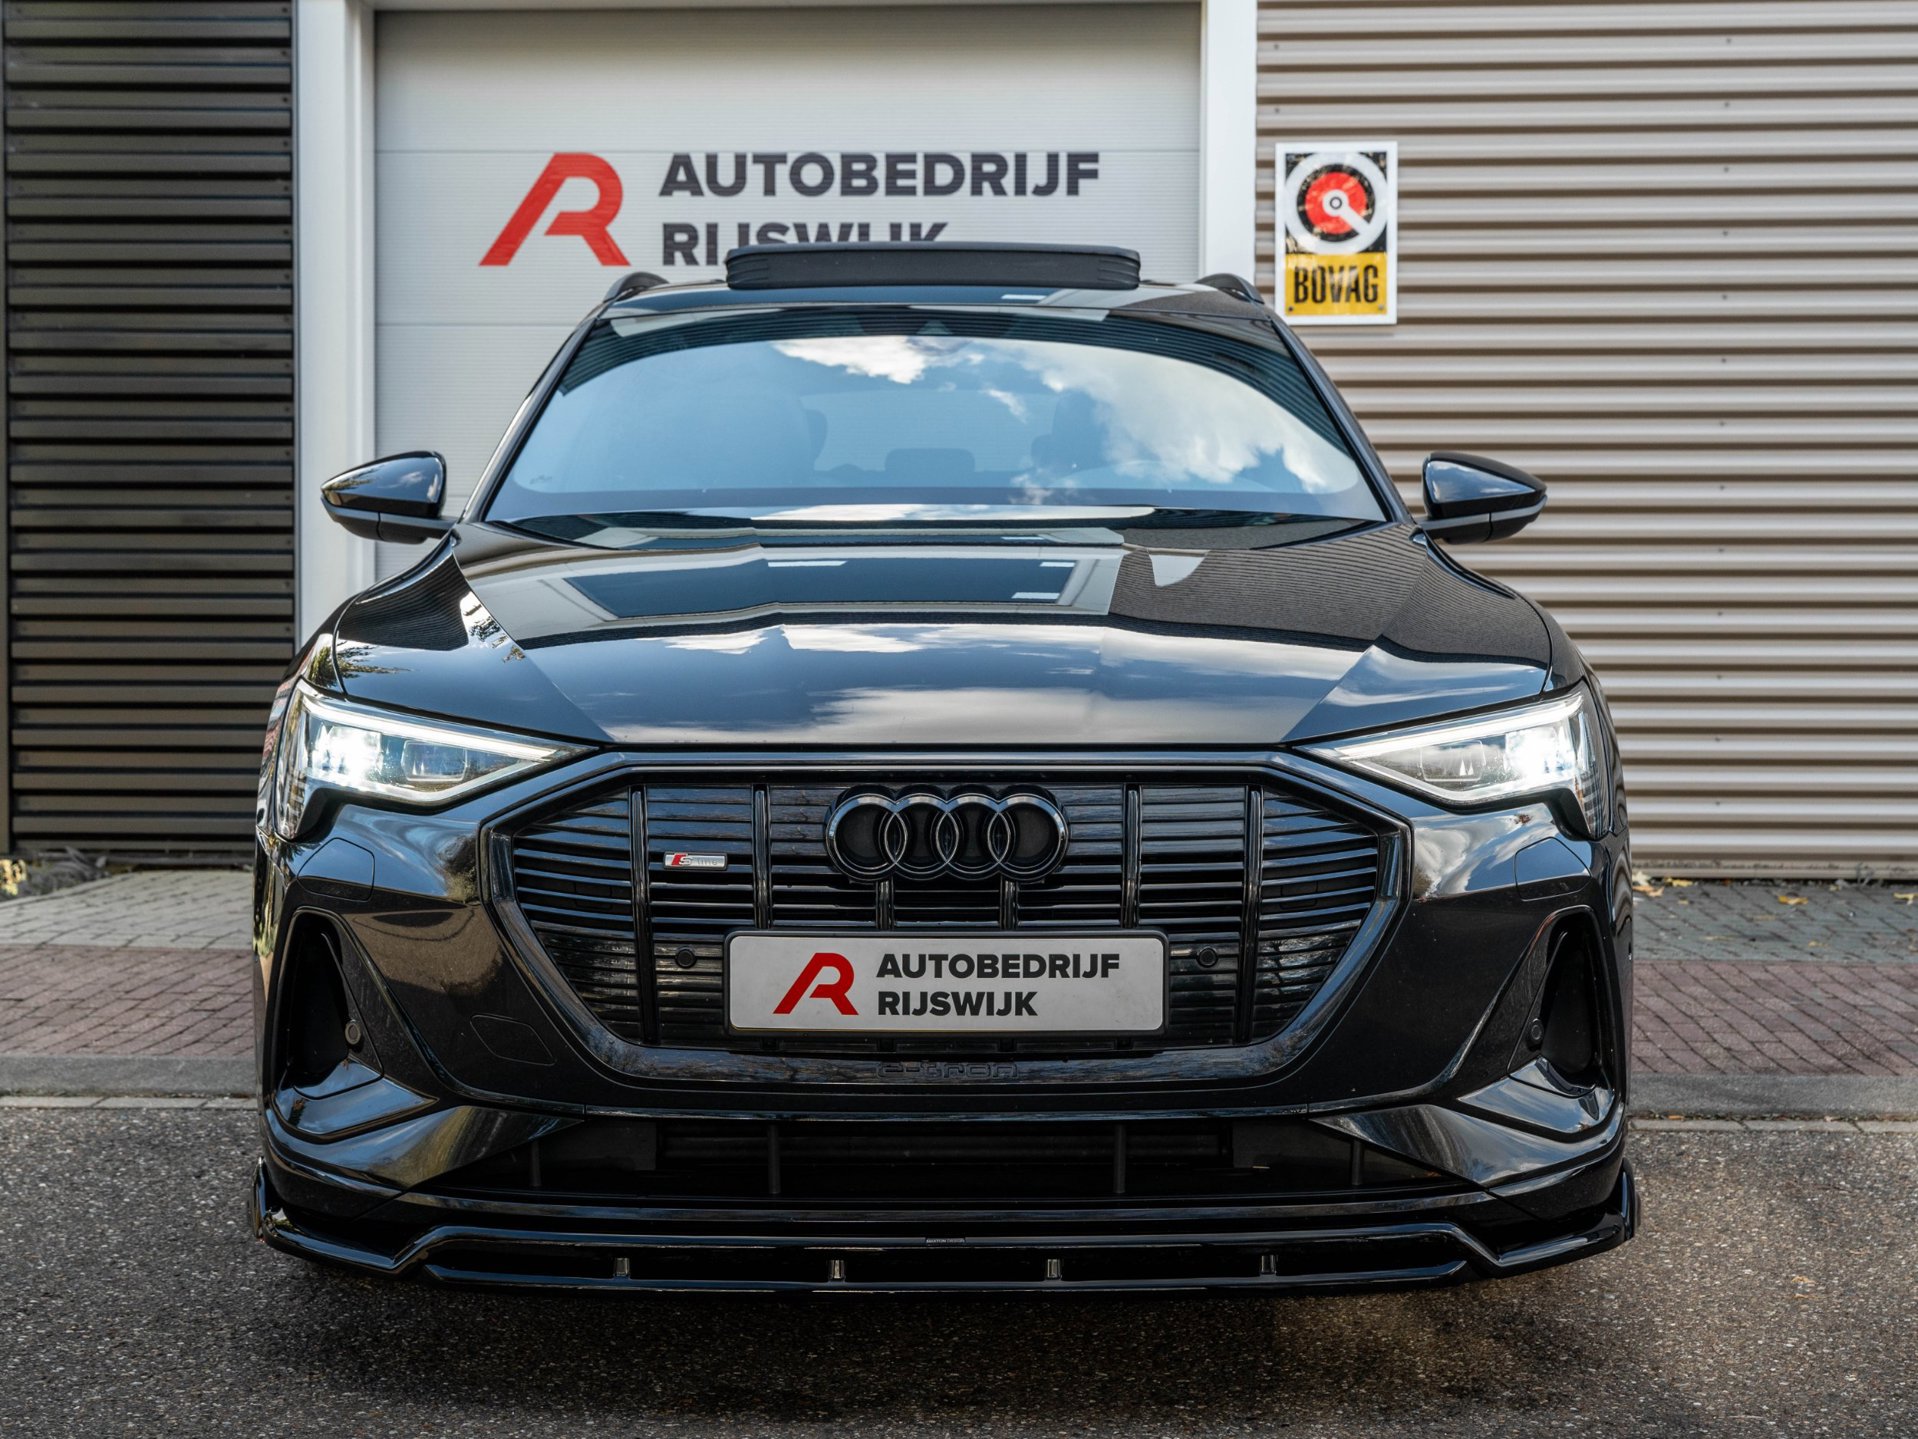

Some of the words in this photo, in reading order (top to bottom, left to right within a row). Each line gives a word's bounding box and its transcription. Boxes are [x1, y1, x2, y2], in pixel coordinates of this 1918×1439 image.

[658, 152, 1100, 198] AUTOBEDRIJF
[1293, 263, 1380, 304] BOVAG
[876, 953, 1120, 979] AUTOBEDRIJF
[877, 991, 1039, 1017] RIJSWIJK
